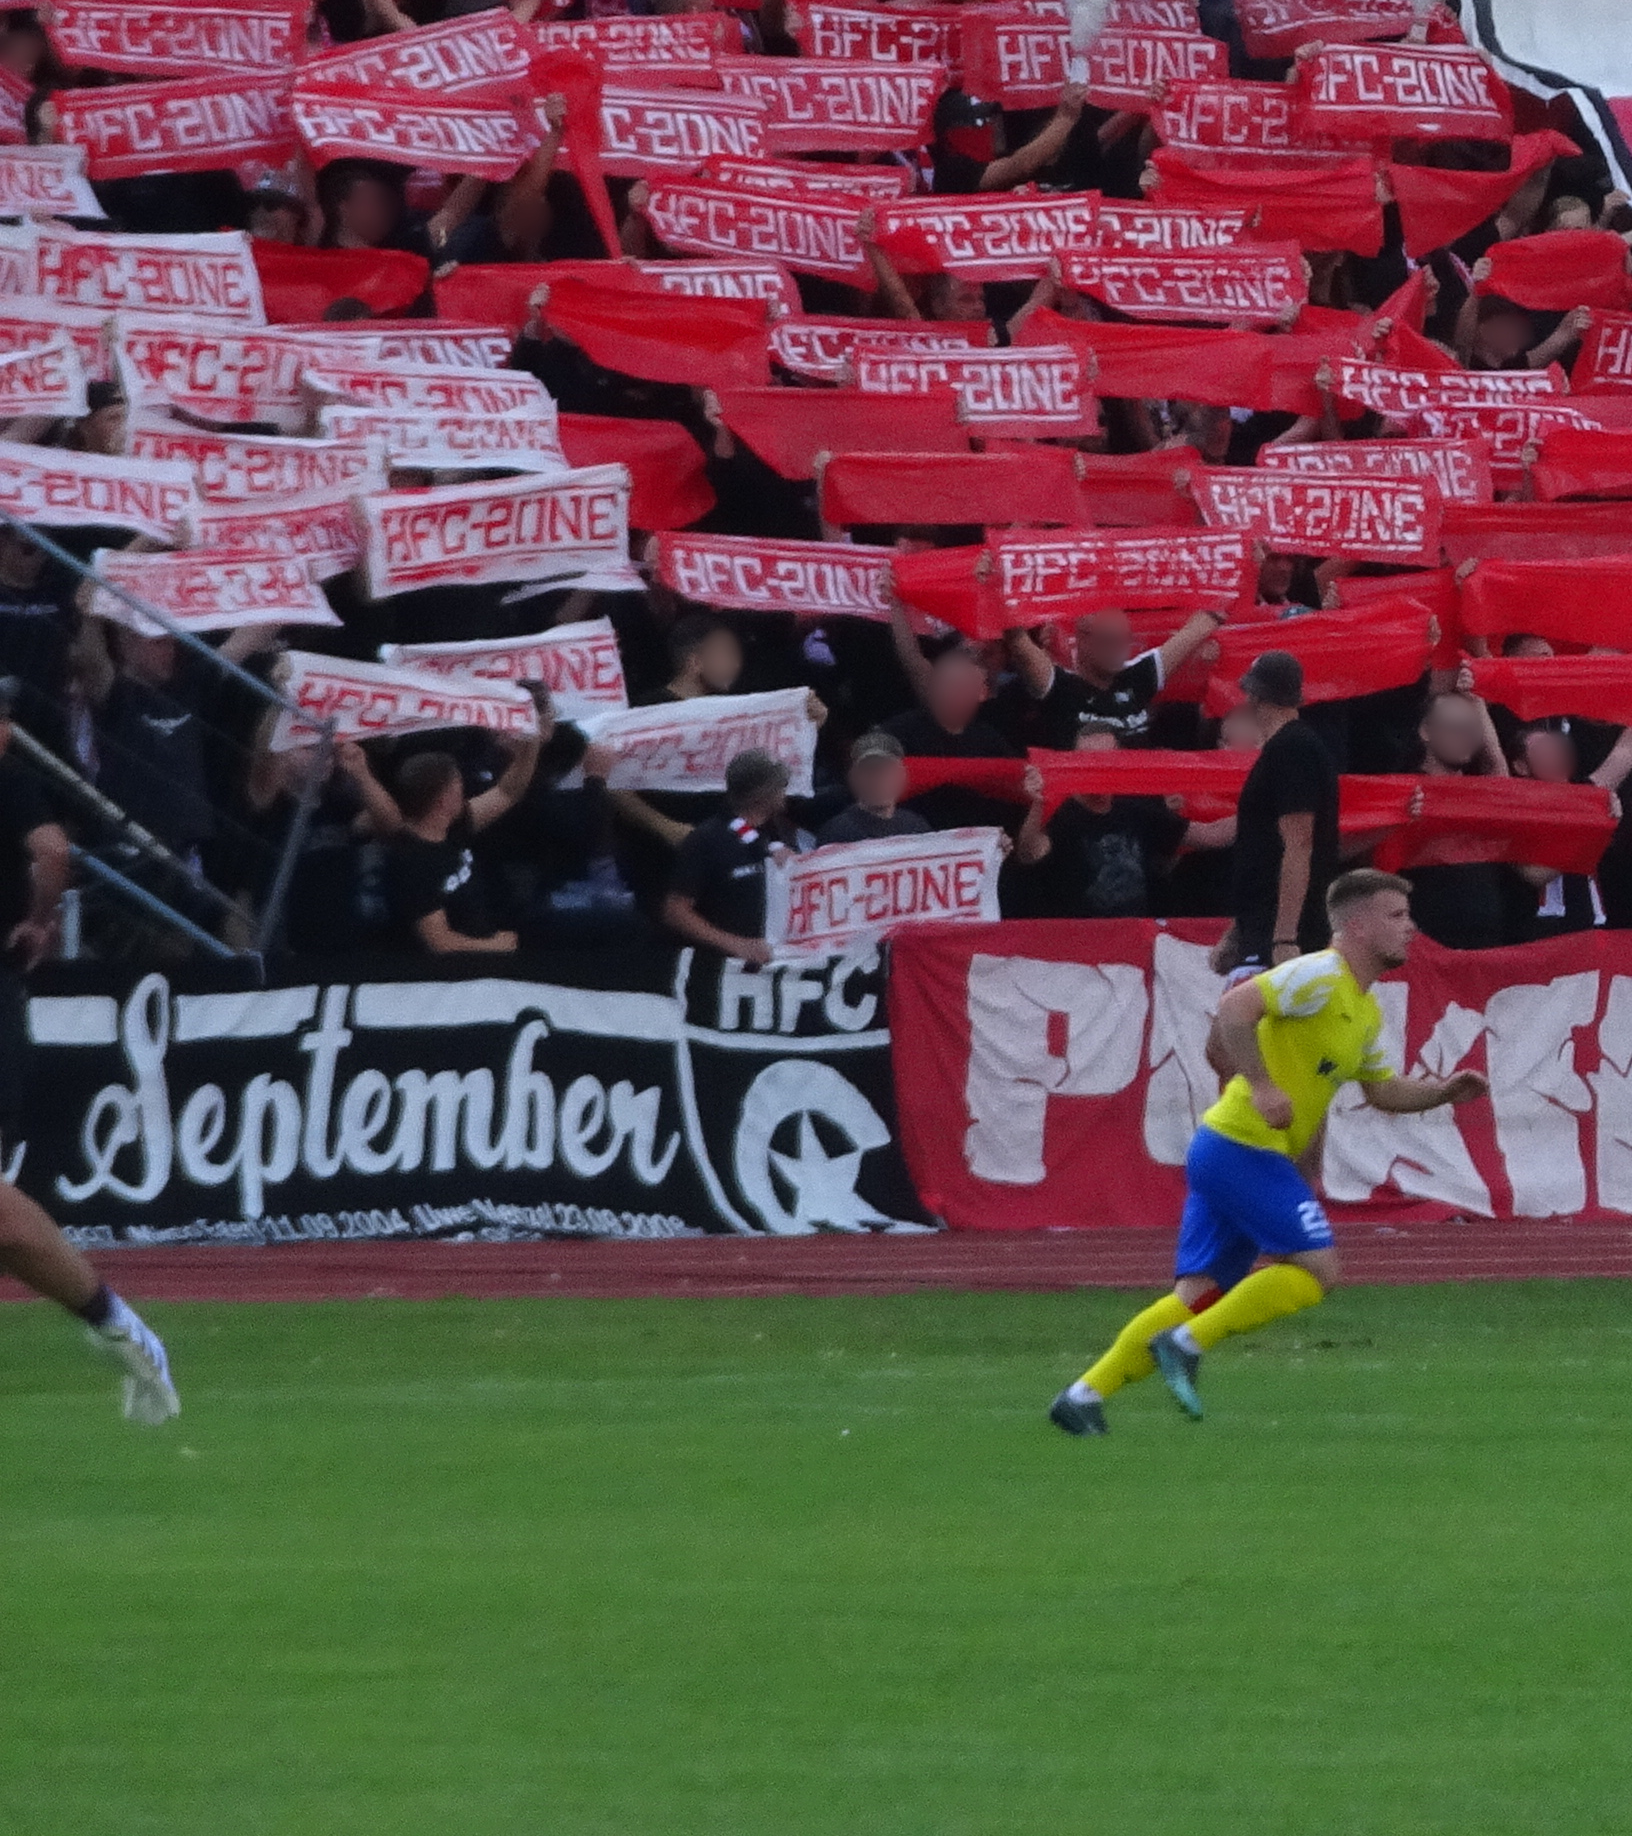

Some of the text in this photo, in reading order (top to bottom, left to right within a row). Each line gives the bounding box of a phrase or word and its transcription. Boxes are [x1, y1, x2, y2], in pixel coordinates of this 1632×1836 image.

[56, 11, 291, 63] HFC-ZONE
[297, 102, 519, 154] HFC-ZONE
[603, 109, 763, 159] C-ZONE
[650, 193, 864, 262] HFC-ZONE
[382, 495, 616, 562] HFC-ZONE
[1212, 485, 1424, 542] HFC-ZONE
[675, 551, 888, 610] HFC-ZONE
[791, 862, 984, 934] HFC-ZONE
[719, 958, 878, 1034] HFC
[58, 973, 683, 1220] September
